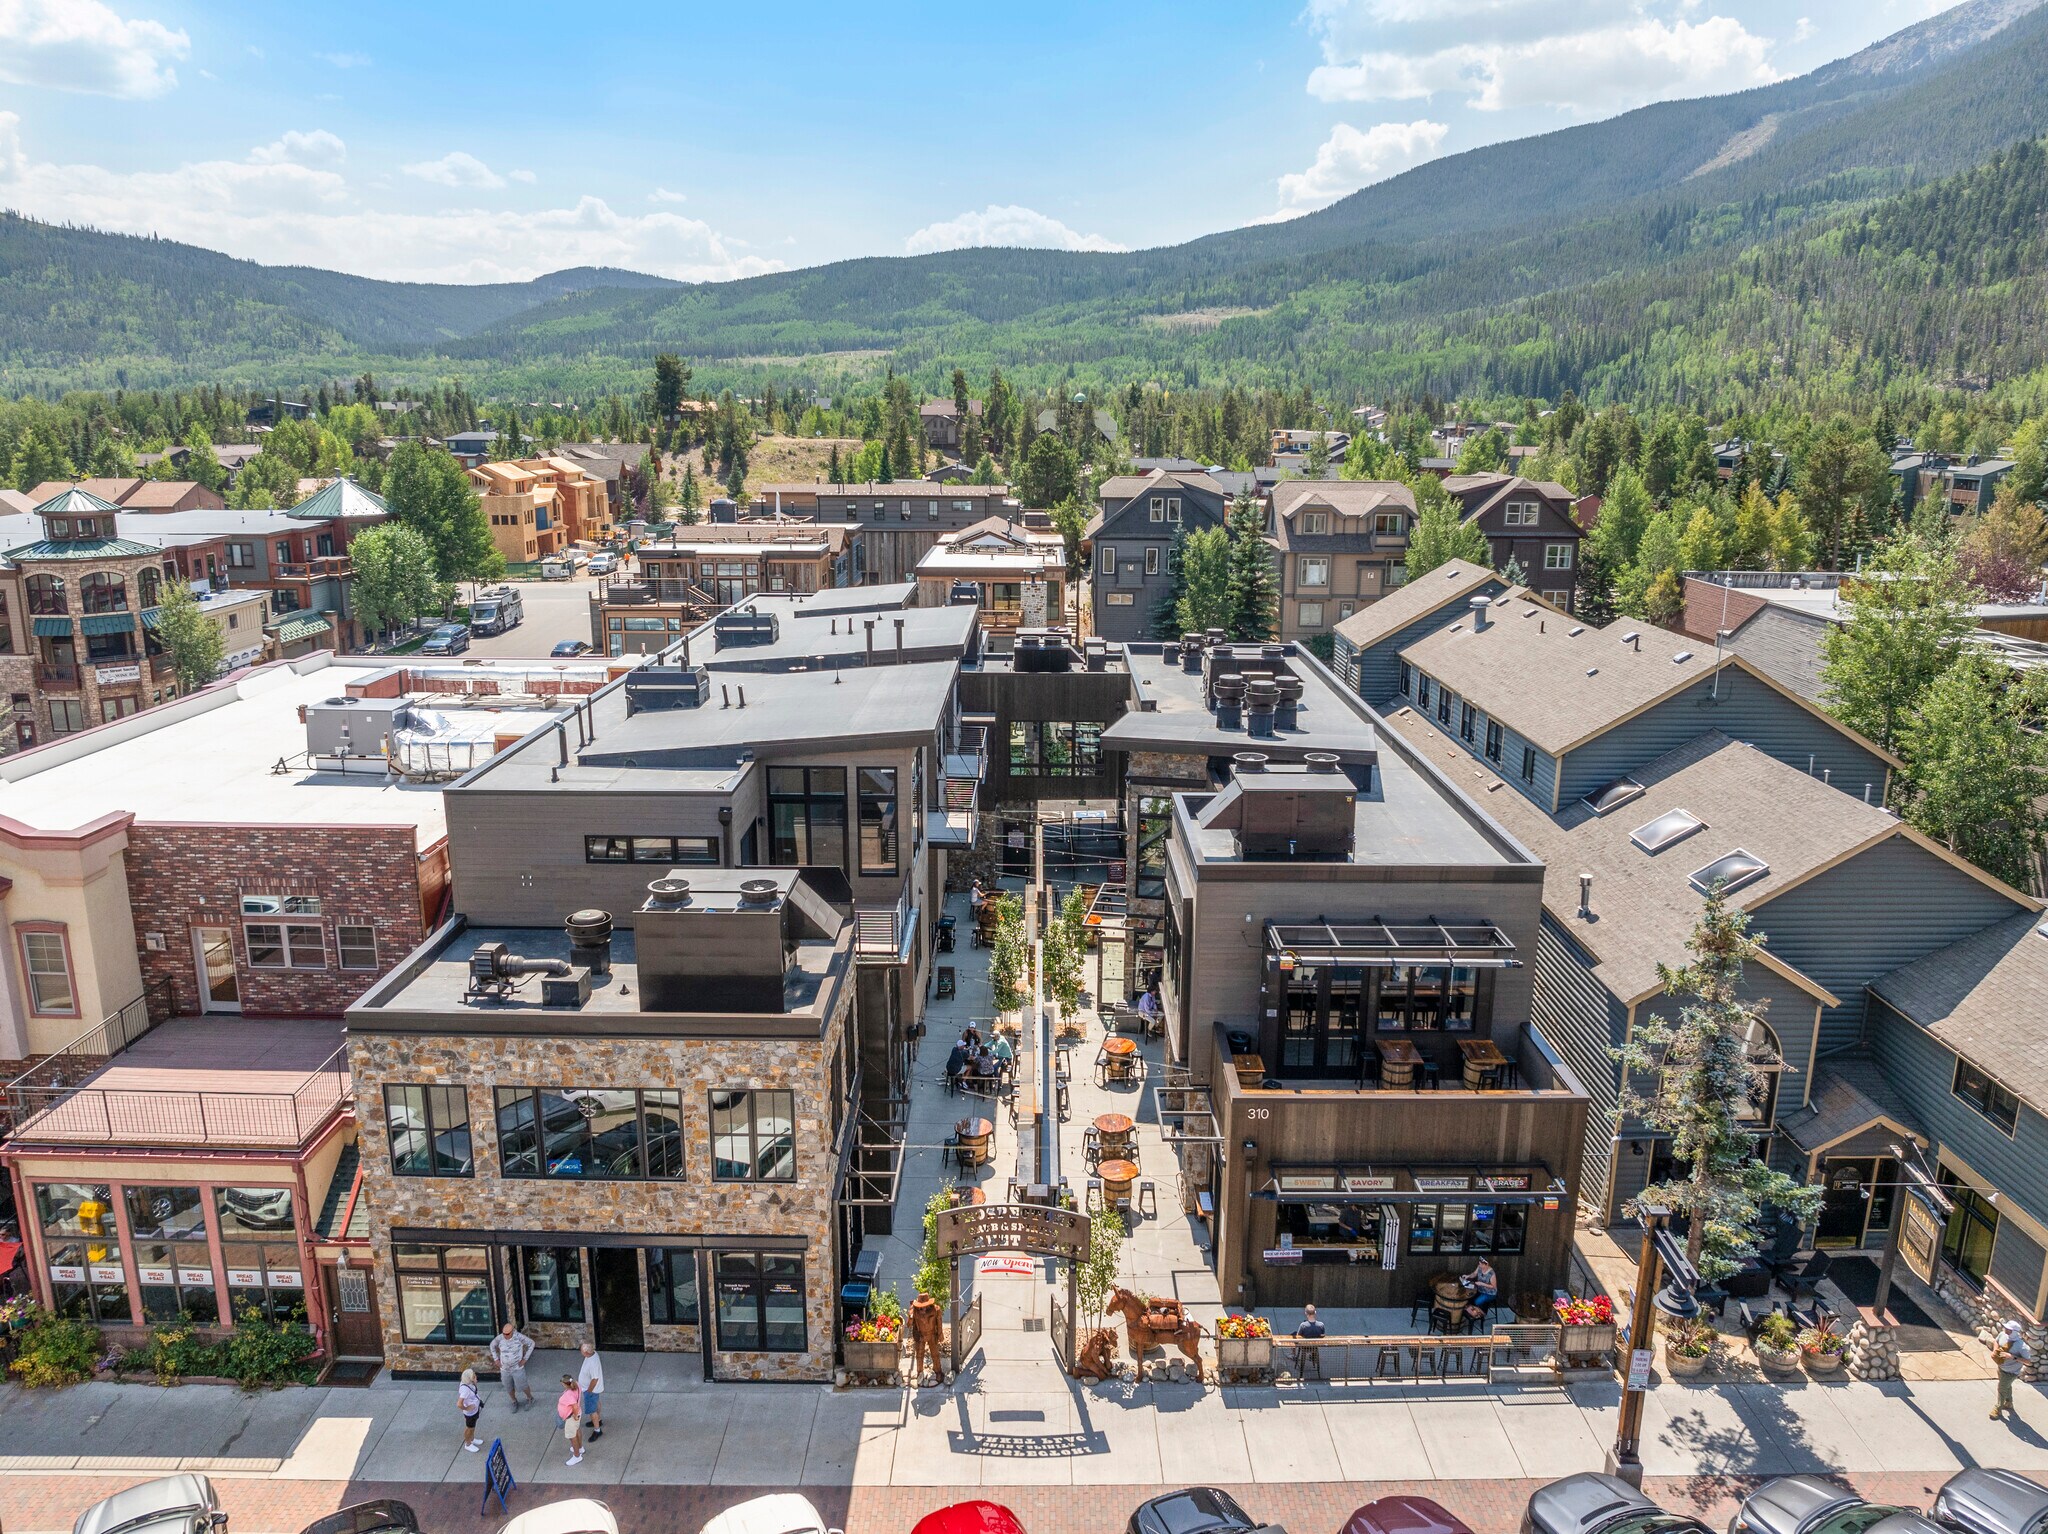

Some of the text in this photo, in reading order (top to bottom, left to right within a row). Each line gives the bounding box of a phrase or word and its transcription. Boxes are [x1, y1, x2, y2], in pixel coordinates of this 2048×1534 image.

[1247, 1108, 1270, 1120] 310
[1420, 1179, 1466, 1187] BREAKFAST
[950, 1206, 1077, 1229] PROSPECTORS
[1000, 1221, 1009, 1231] &
[1010, 1222, 1059, 1238] SPIRITS
[980, 1259, 999, 1269] NOW
